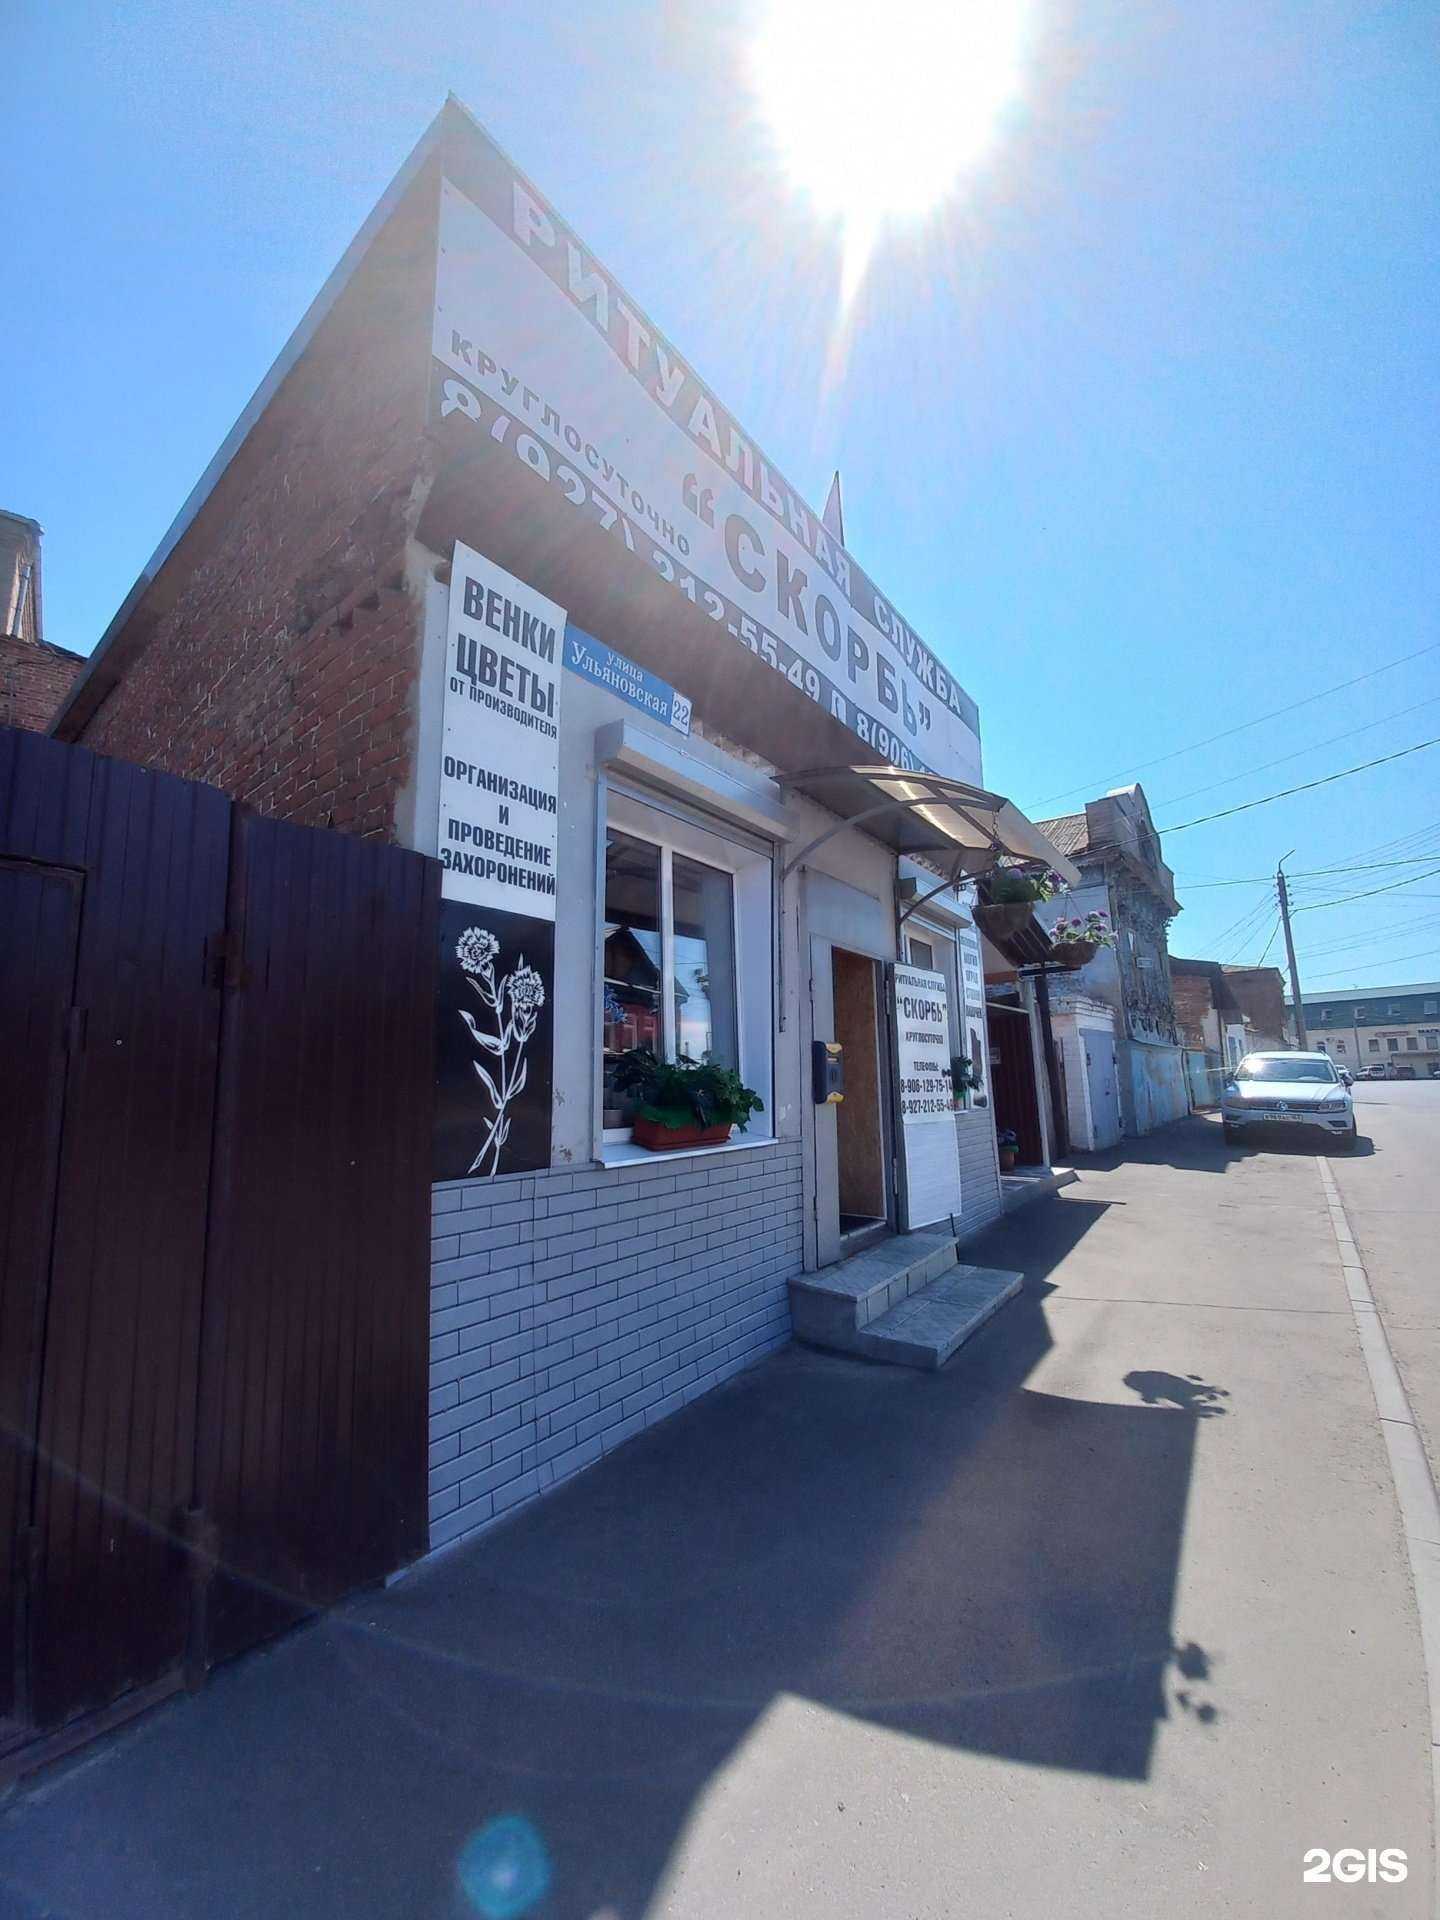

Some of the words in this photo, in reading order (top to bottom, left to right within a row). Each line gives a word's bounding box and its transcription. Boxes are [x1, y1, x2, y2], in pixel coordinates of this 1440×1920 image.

[451, 329, 691, 556] КРУГЛОСУТОЧНО
[512, 181, 852, 598] РИТУАЛЬНАЯ
[873, 596, 962, 715] СЛУЖБА
[463, 576, 556, 664] ВЕНКИ
[456, 632, 555, 718] ЦВЕТЫ
[570, 640, 669, 718] Ульяновская
[606, 651, 645, 683] улица
[450, 676, 466, 695] ОТ
[469, 684, 558, 739] ПРОИЗВОДИТЕЛЯ
[671, 700, 690, 726] 22
[443, 755, 557, 814] ОРГАНИЗАЦИЯ
[498, 804, 510, 826] И
[440, 847, 556, 896] ЗАХОРОНЕНИЙ
[448, 818, 552, 867] ПРОВЕДЕНИЕ
